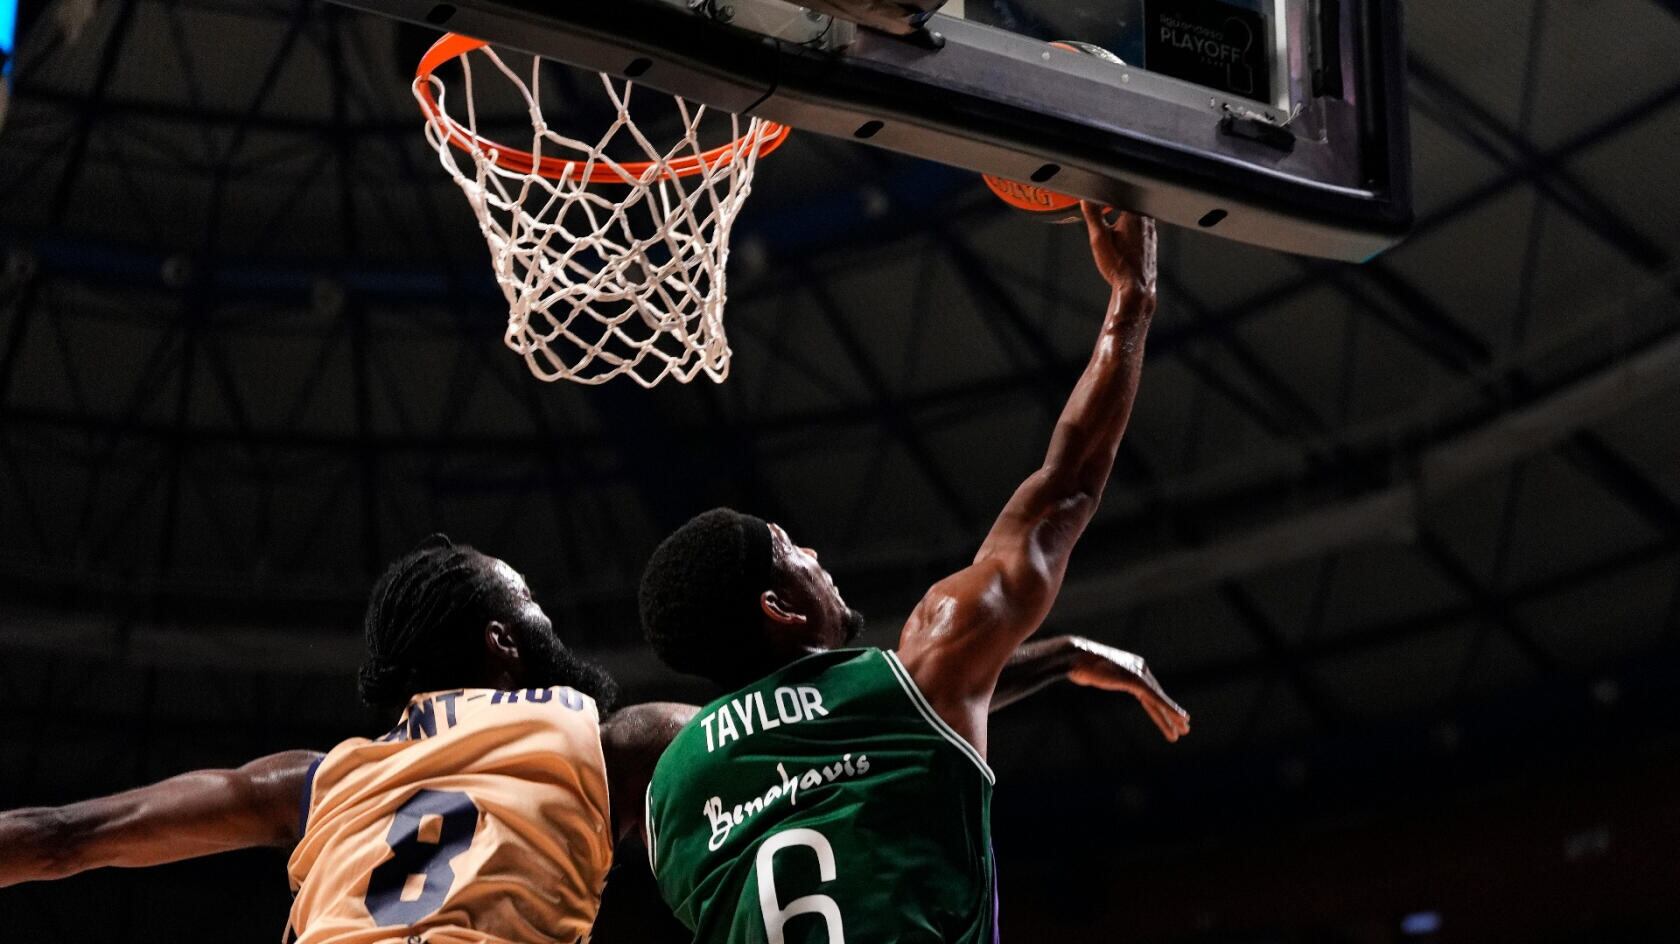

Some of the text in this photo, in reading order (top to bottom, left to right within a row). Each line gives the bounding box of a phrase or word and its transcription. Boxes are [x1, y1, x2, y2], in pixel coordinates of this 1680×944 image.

[1160, 26, 1241, 63] PLAYOFF
[700, 686, 829, 753] TAYLOR
[702, 753, 870, 852] Benahavis
[364, 788, 479, 927] 8
[756, 828, 846, 944] 6
